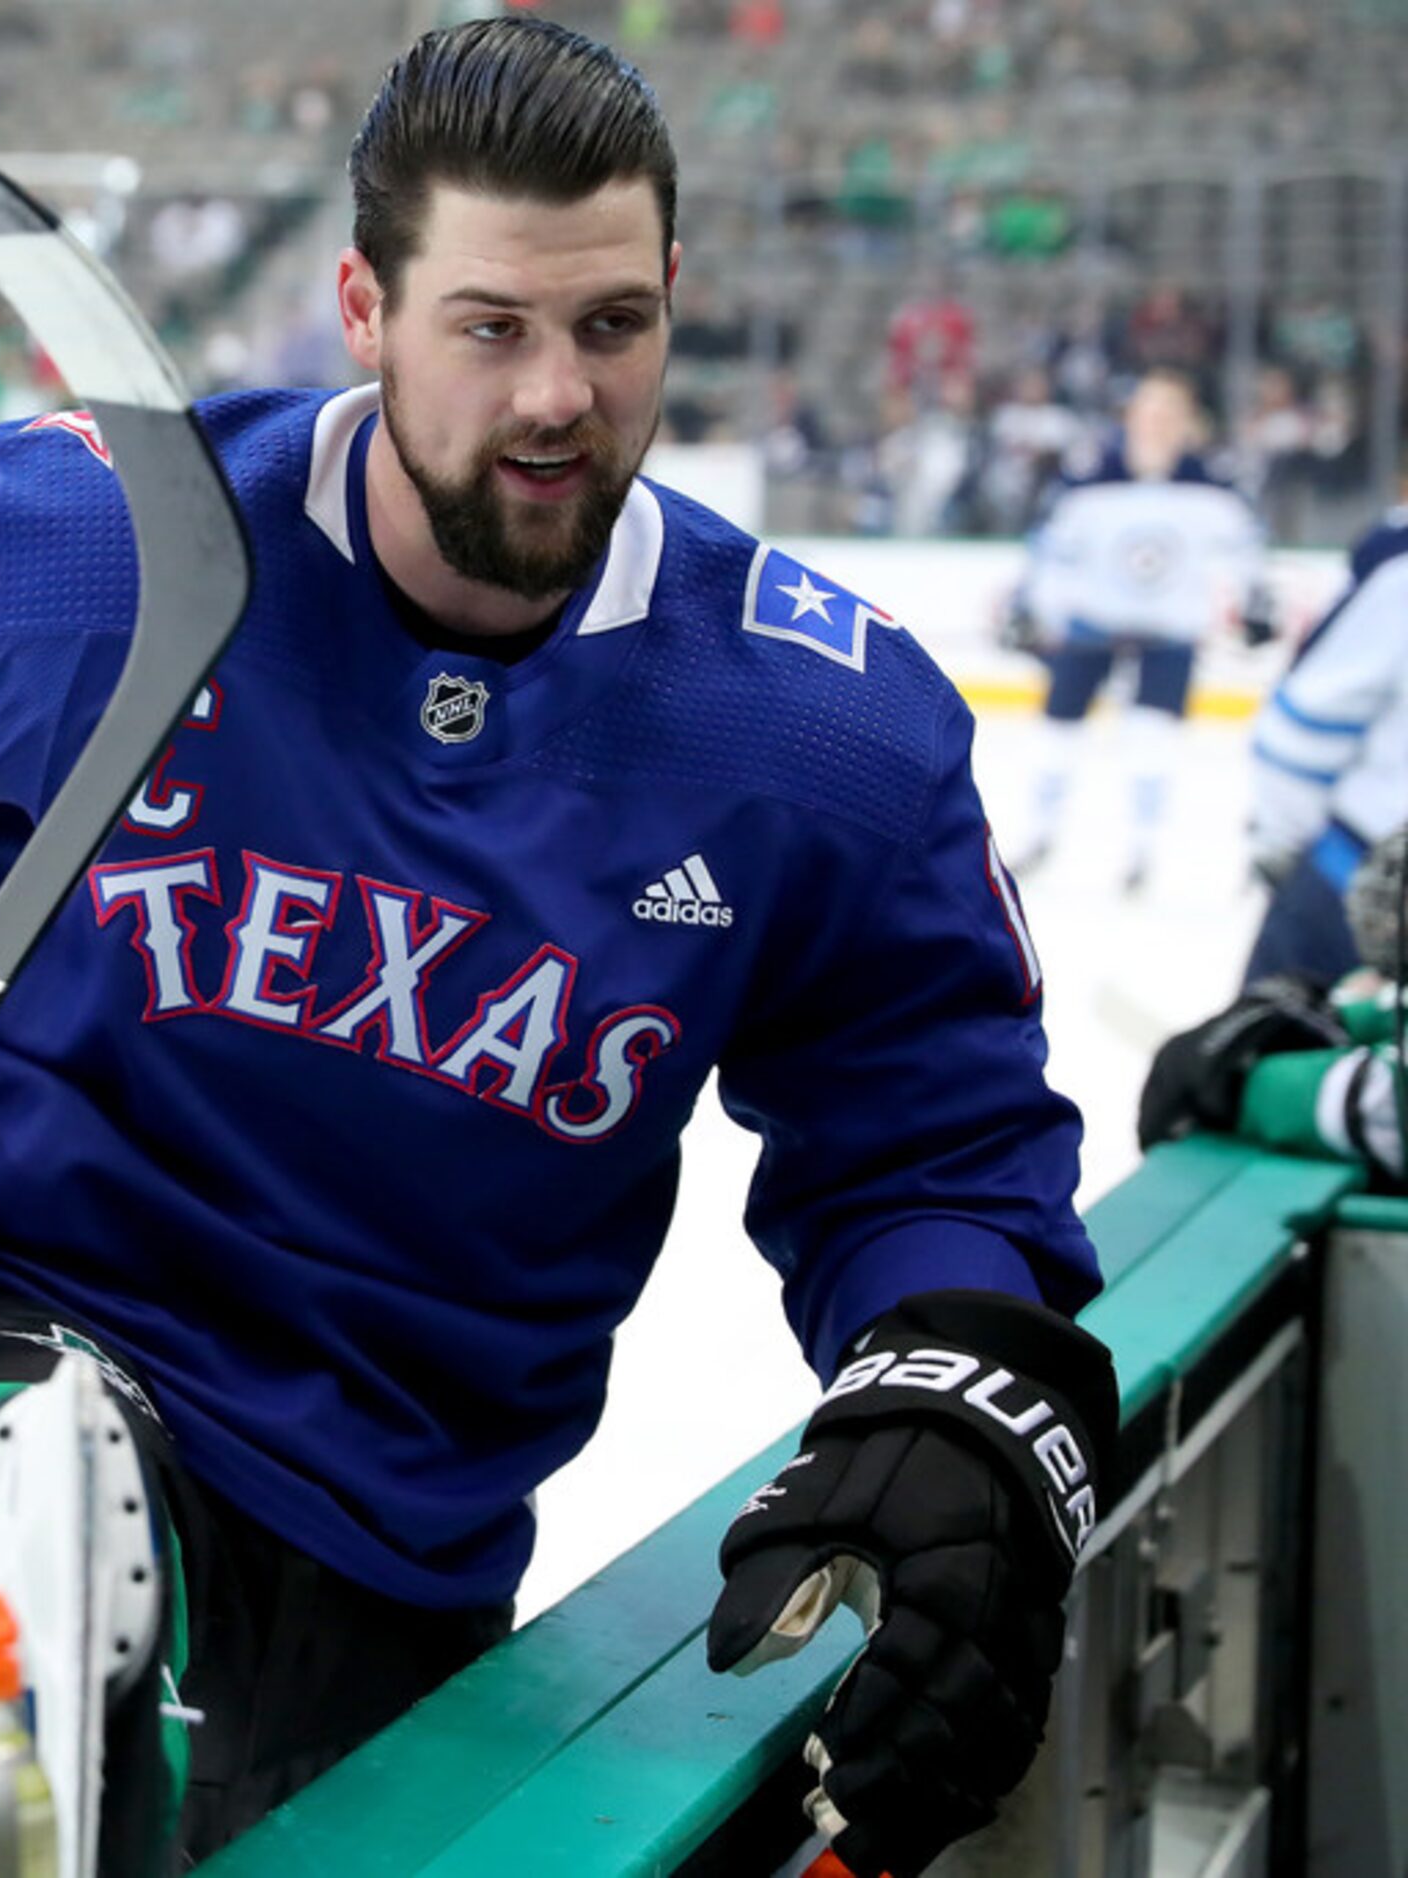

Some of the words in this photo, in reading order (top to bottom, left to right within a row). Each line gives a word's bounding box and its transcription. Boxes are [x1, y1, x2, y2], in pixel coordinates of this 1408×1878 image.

[434, 697, 476, 727] NHL
[632, 897, 733, 928] adidas
[88, 848, 681, 1143] TEXAS
